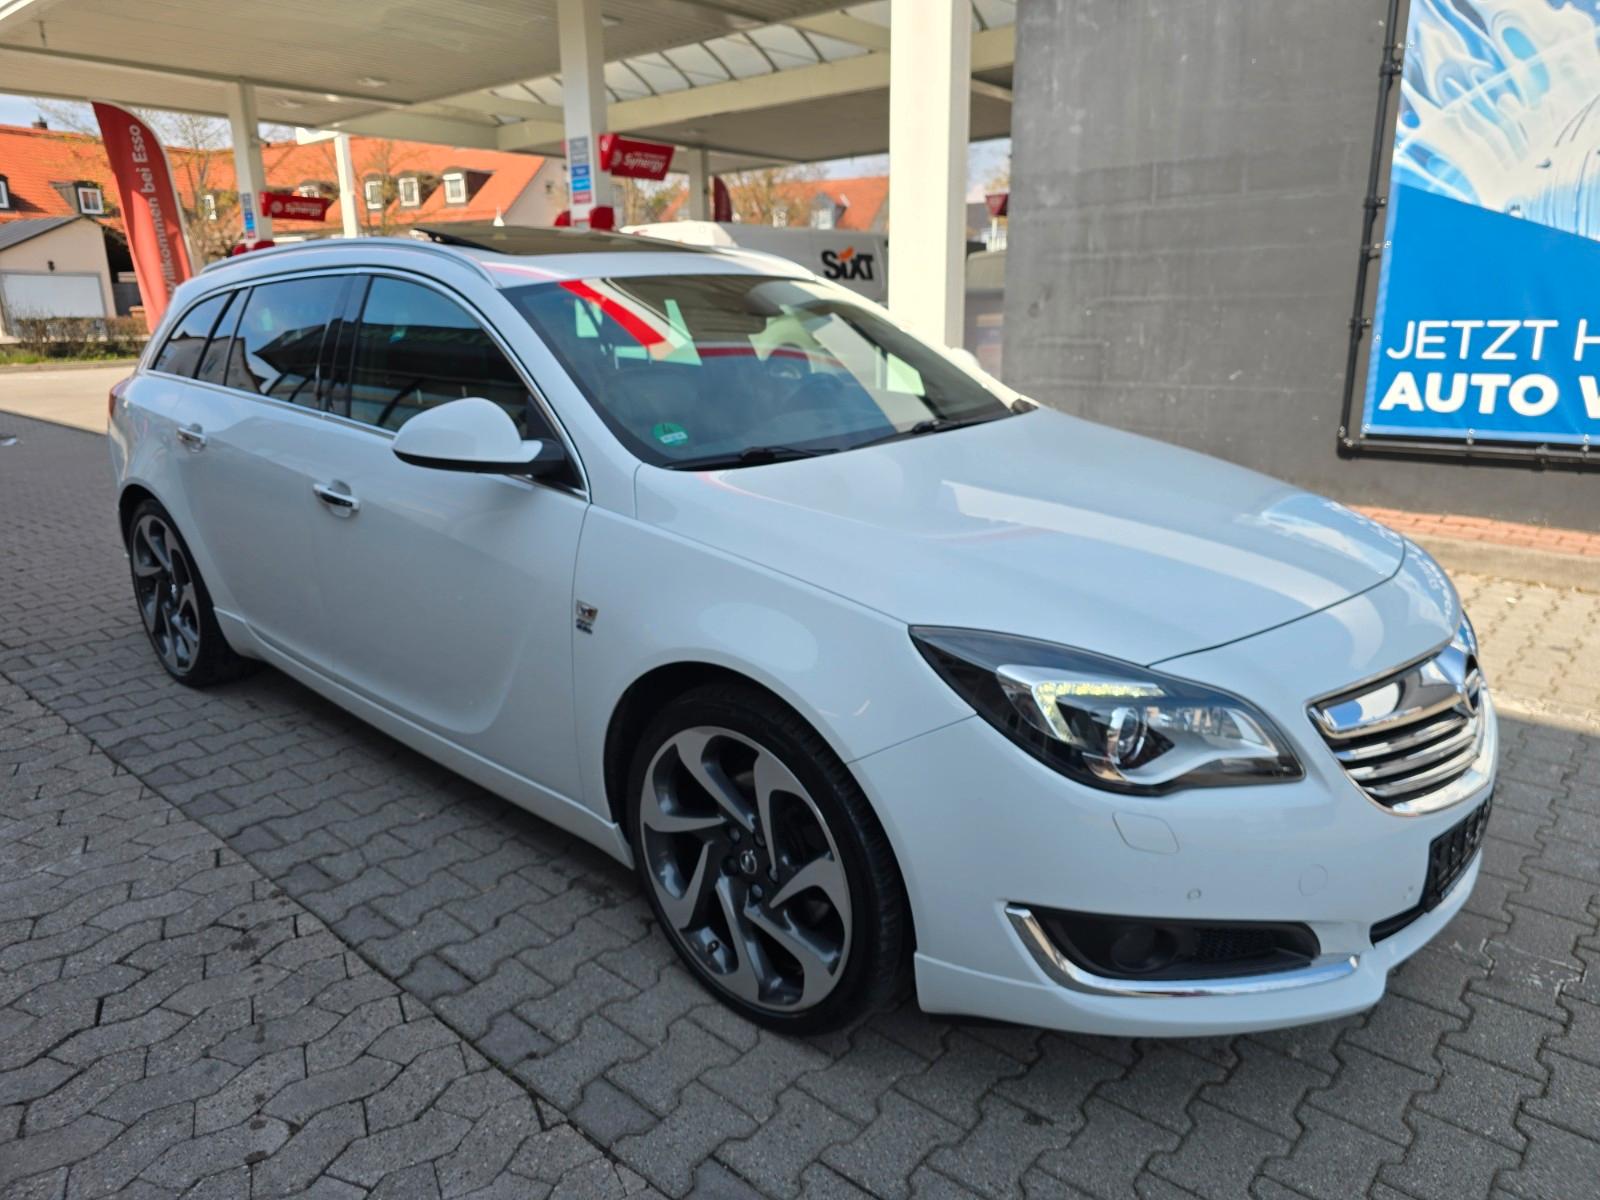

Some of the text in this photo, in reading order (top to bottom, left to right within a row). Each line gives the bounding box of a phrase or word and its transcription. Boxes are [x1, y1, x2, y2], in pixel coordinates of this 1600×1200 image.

[129, 124, 149, 163] Esso
[624, 151, 667, 173] Synergy
[136, 167, 156, 193] bei
[1386, 319, 1559, 361] JETZT
[1378, 371, 1559, 417] AUTO
